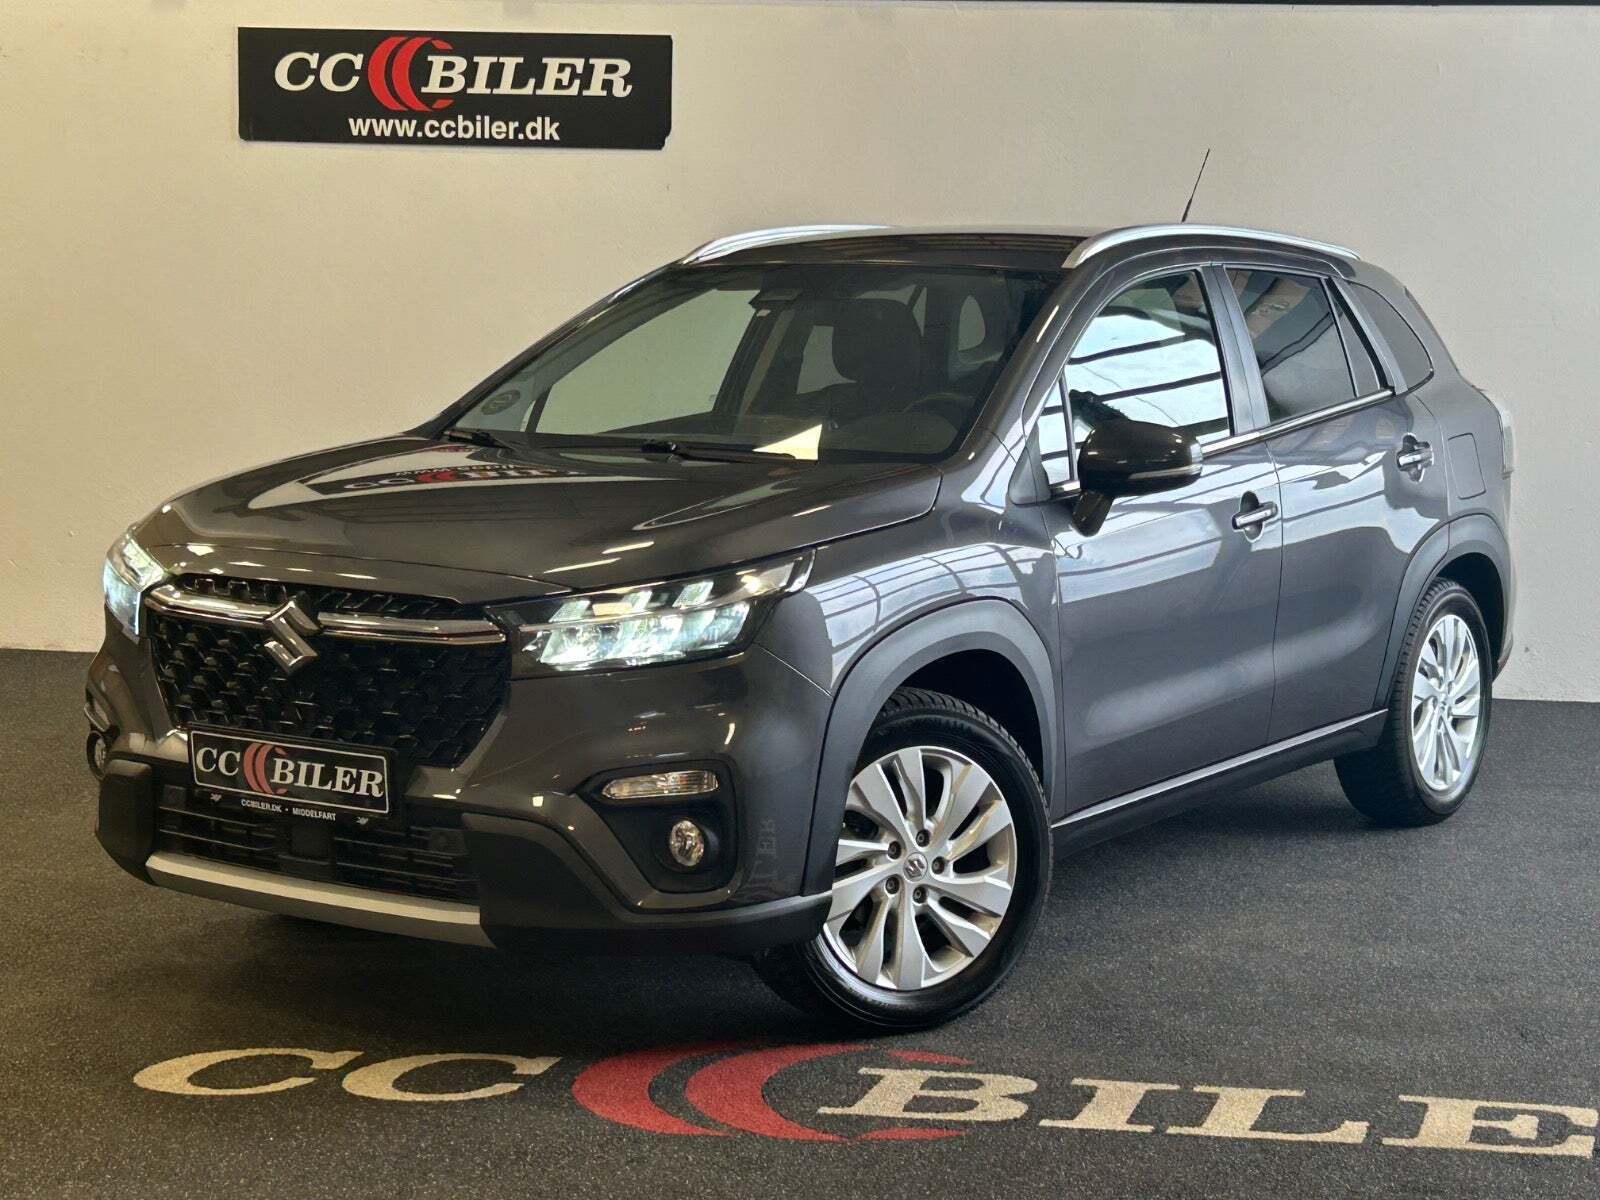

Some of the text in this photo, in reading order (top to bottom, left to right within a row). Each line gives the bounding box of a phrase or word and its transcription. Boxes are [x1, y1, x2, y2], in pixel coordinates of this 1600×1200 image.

[274, 51, 633, 98] CC BILER
[348, 115, 561, 142] www.ccbiler.dk
[195, 747, 385, 798] CC BILER
[292, 807, 337, 821] MIDDELFART
[817, 1066, 1598, 1159] BILE
